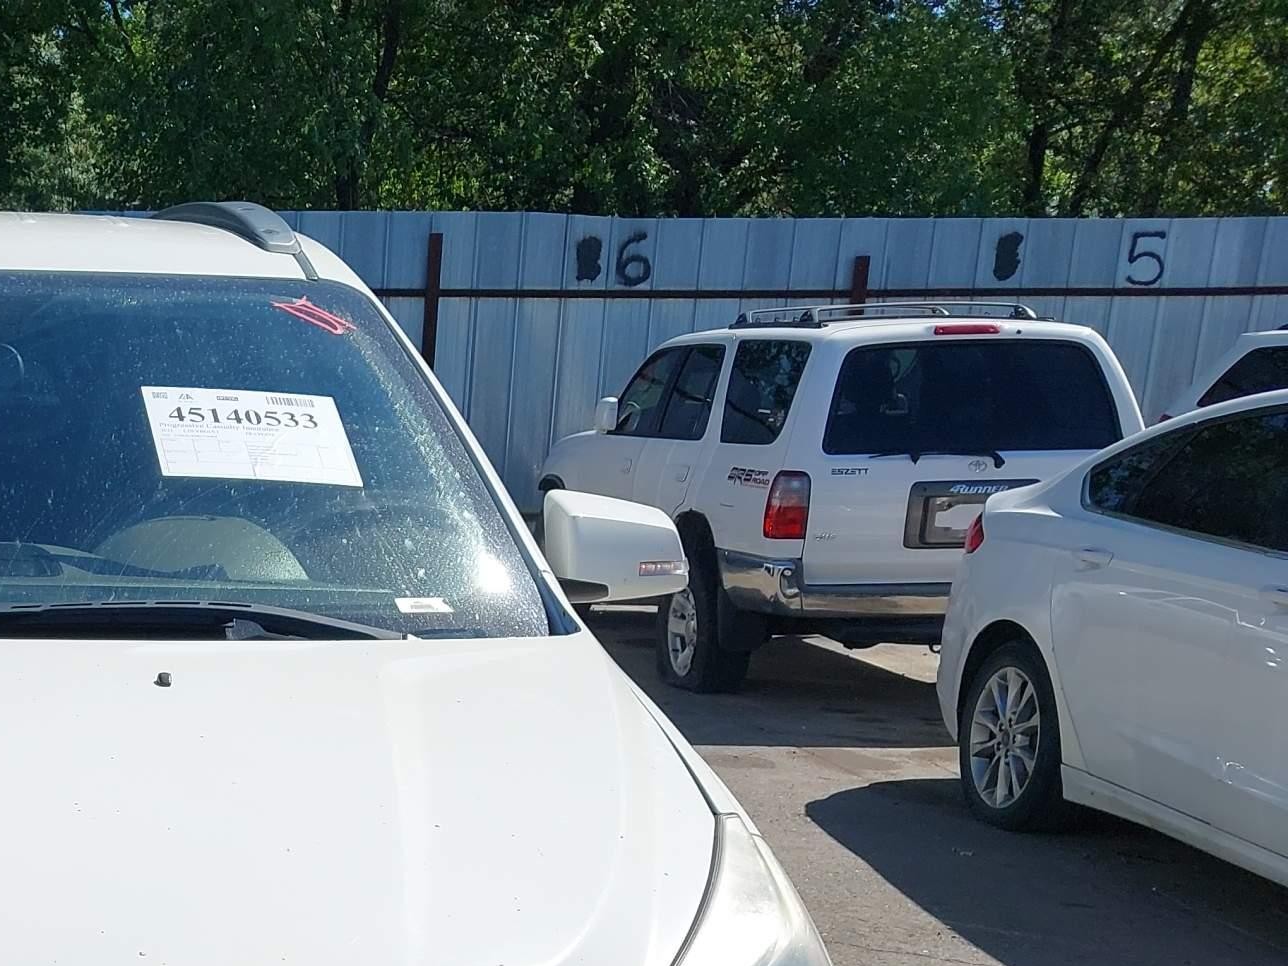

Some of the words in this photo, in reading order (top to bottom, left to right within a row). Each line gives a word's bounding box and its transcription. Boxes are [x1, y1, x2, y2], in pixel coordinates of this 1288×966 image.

[616, 232, 651, 287] 6
[1125, 231, 1166, 286] 5
[169, 406, 318, 429] 45140533
